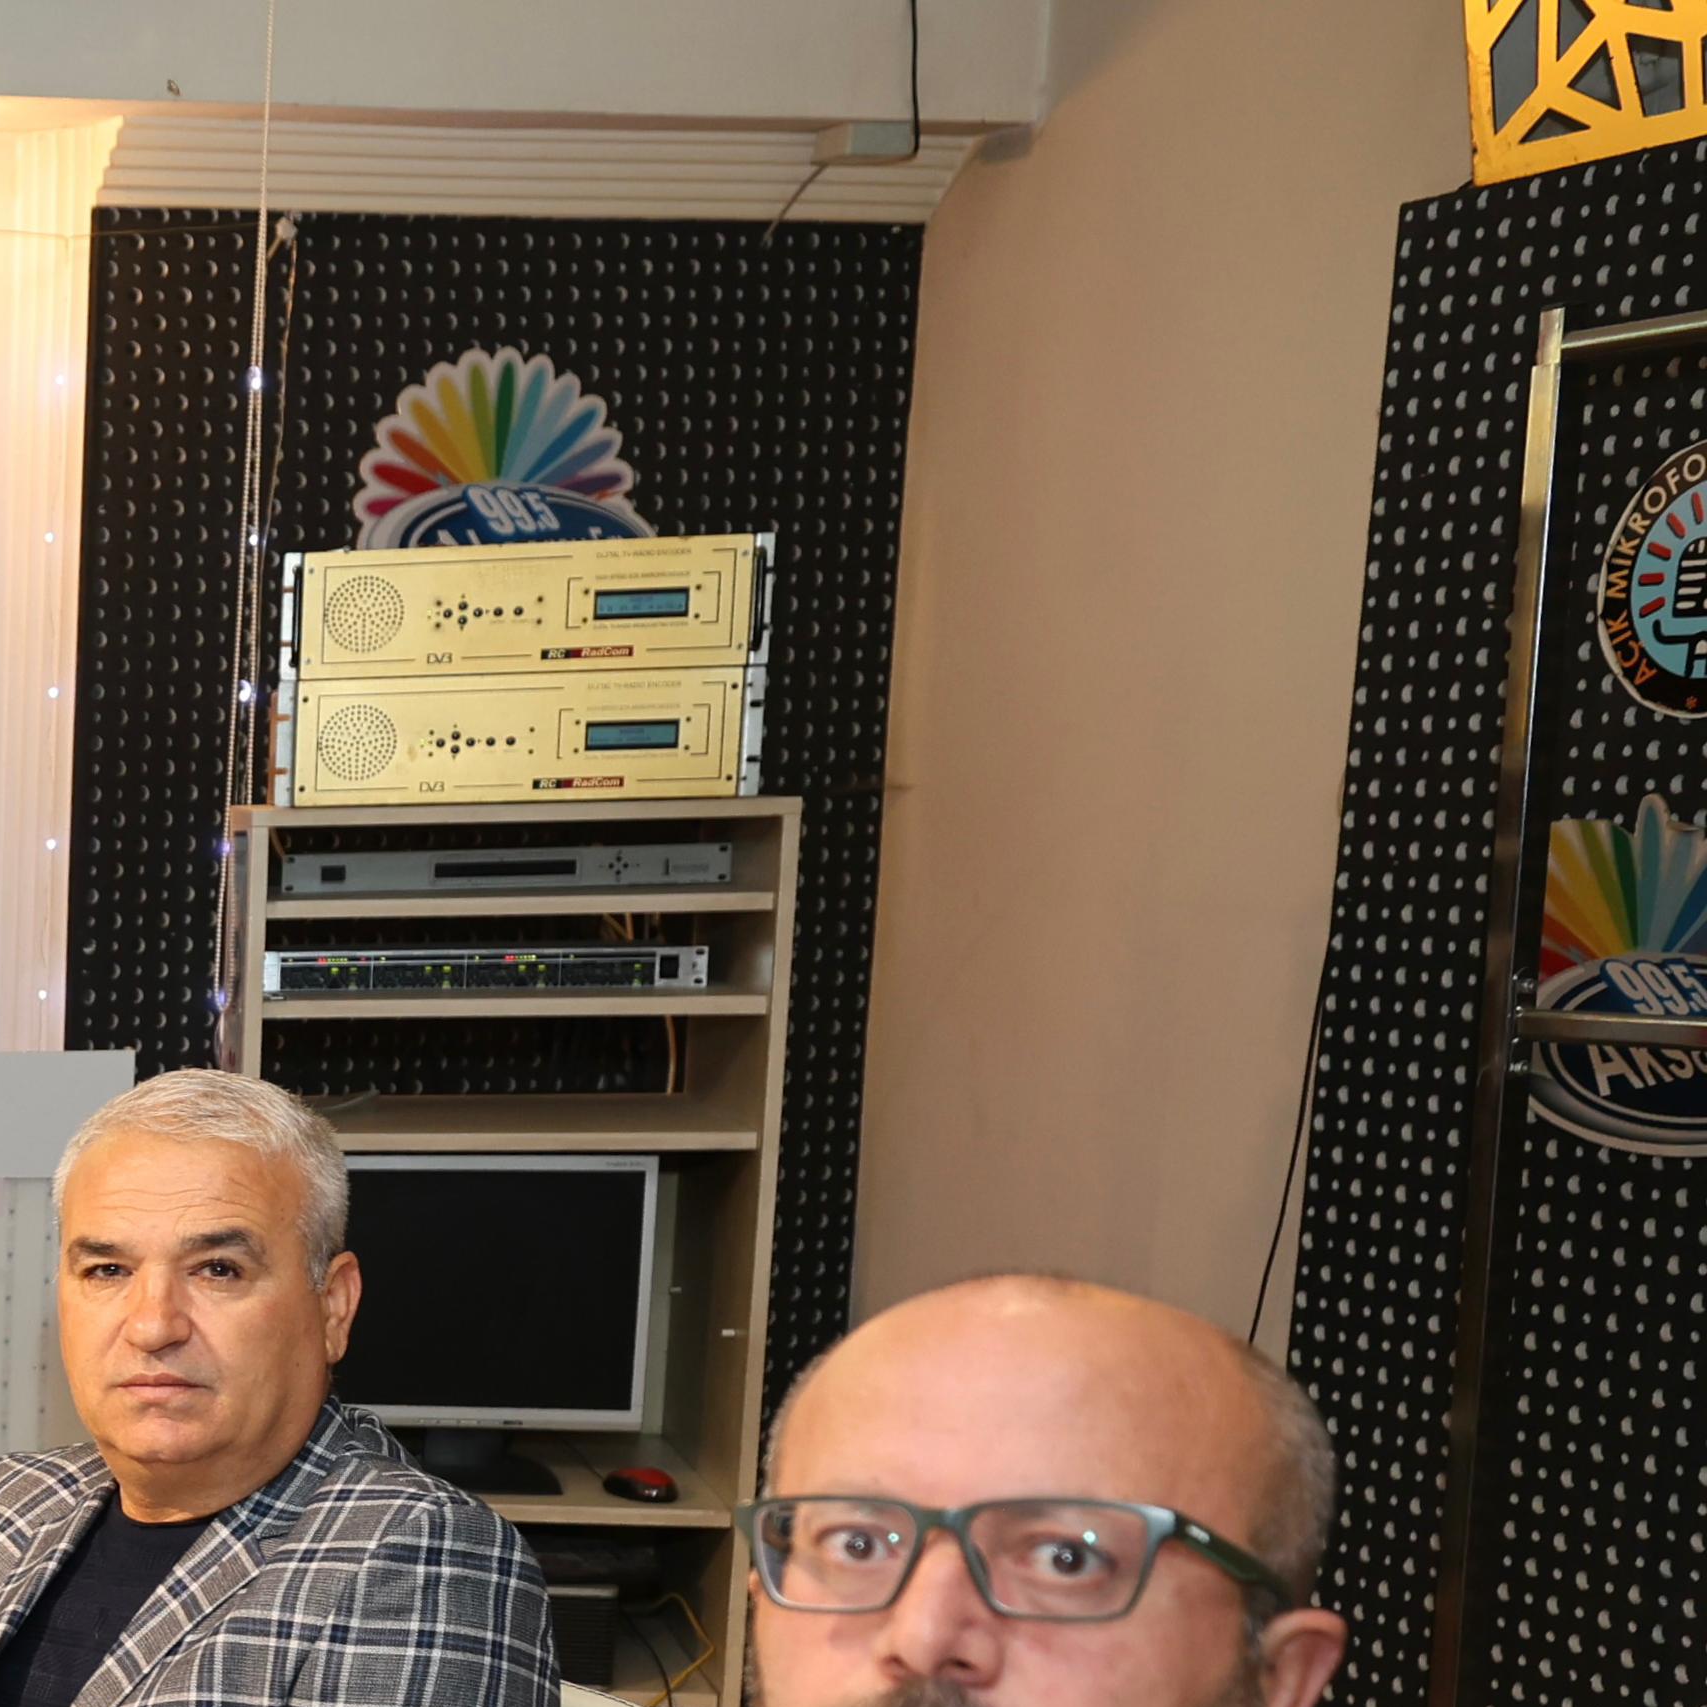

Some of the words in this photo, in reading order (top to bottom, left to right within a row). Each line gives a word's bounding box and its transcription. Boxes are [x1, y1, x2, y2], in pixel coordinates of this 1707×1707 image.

[547, 648, 566, 658] RC
[581, 647, 629, 658] RadCom
[1606, 609, 1658, 686] AÇIK
[539, 779, 557, 788] RC
[573, 777, 620, 787] RadCom
